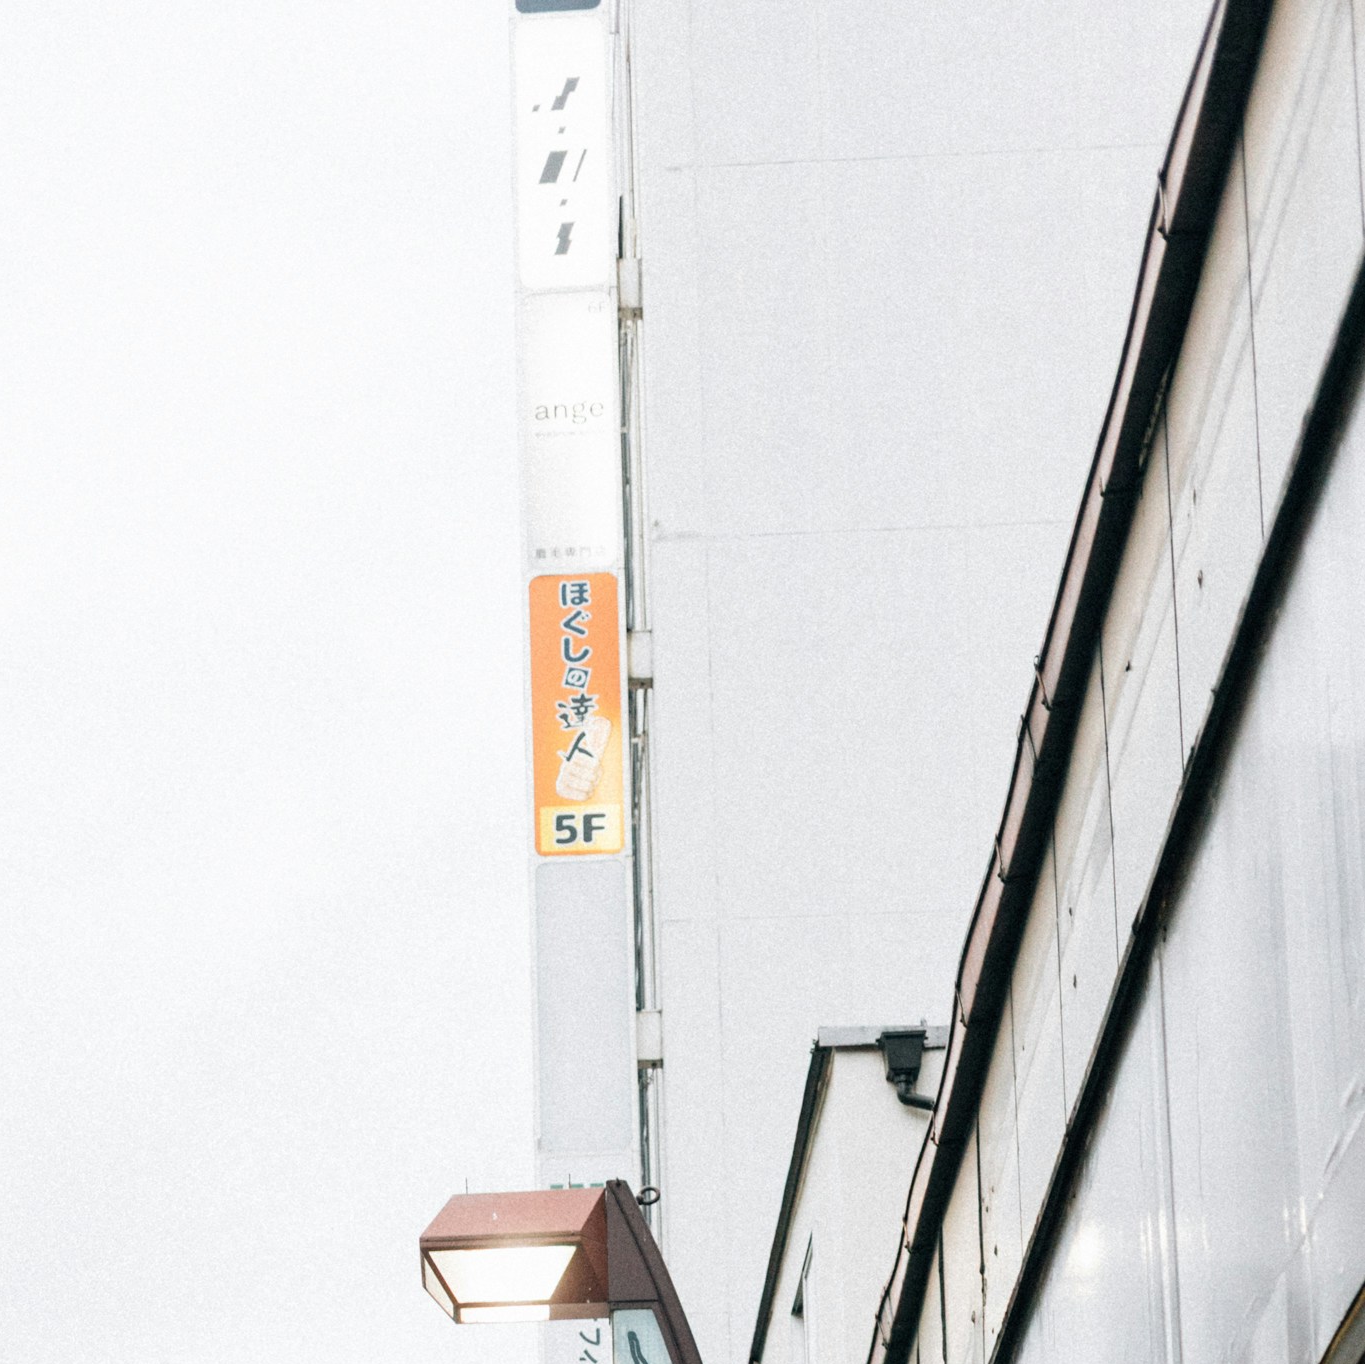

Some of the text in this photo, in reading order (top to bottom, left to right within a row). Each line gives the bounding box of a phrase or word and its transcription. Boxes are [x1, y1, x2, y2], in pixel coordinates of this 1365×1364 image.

[534, 400, 604, 425] ange
[556, 580, 596, 762] ほぐしの達人
[554, 812, 607, 845] 5F
